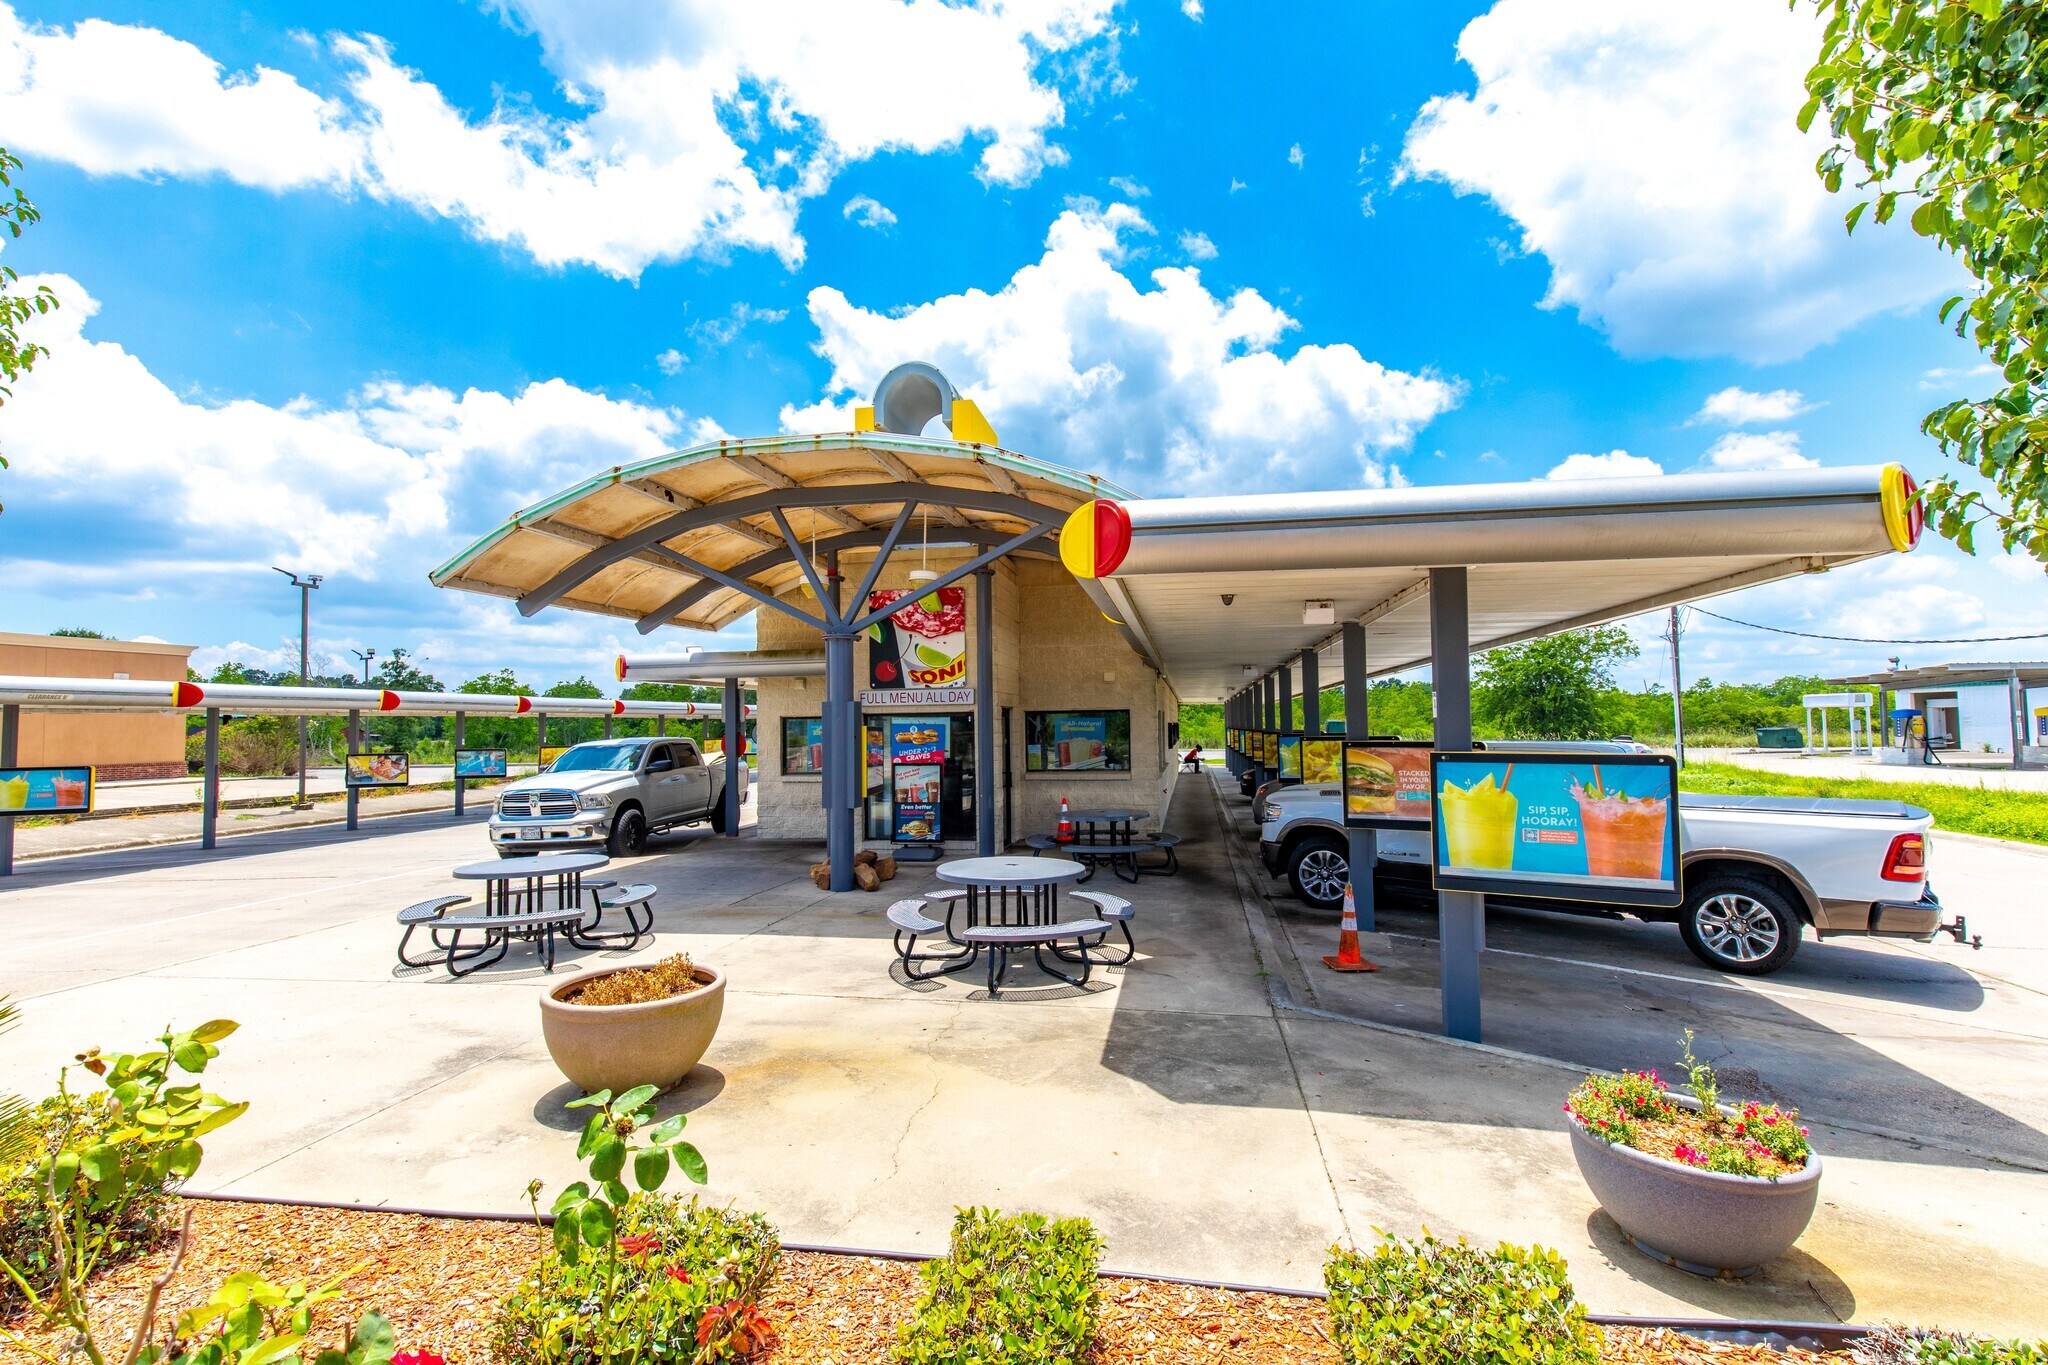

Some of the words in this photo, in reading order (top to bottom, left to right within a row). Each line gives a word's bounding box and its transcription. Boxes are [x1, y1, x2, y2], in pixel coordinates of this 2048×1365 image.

[908, 660, 966, 684] SONI
[860, 692, 886, 704] FULL
[889, 692, 923, 704] MENU
[925, 691, 946, 703] ALL
[948, 691, 971, 703] DAY
[898, 748, 922, 756] UNDER
[906, 752, 931, 761] CRAVES
[1528, 805, 1548, 816] SIP,
[1550, 806, 1570, 817] SIP,
[1521, 816, 1578, 827] HOORAY!
